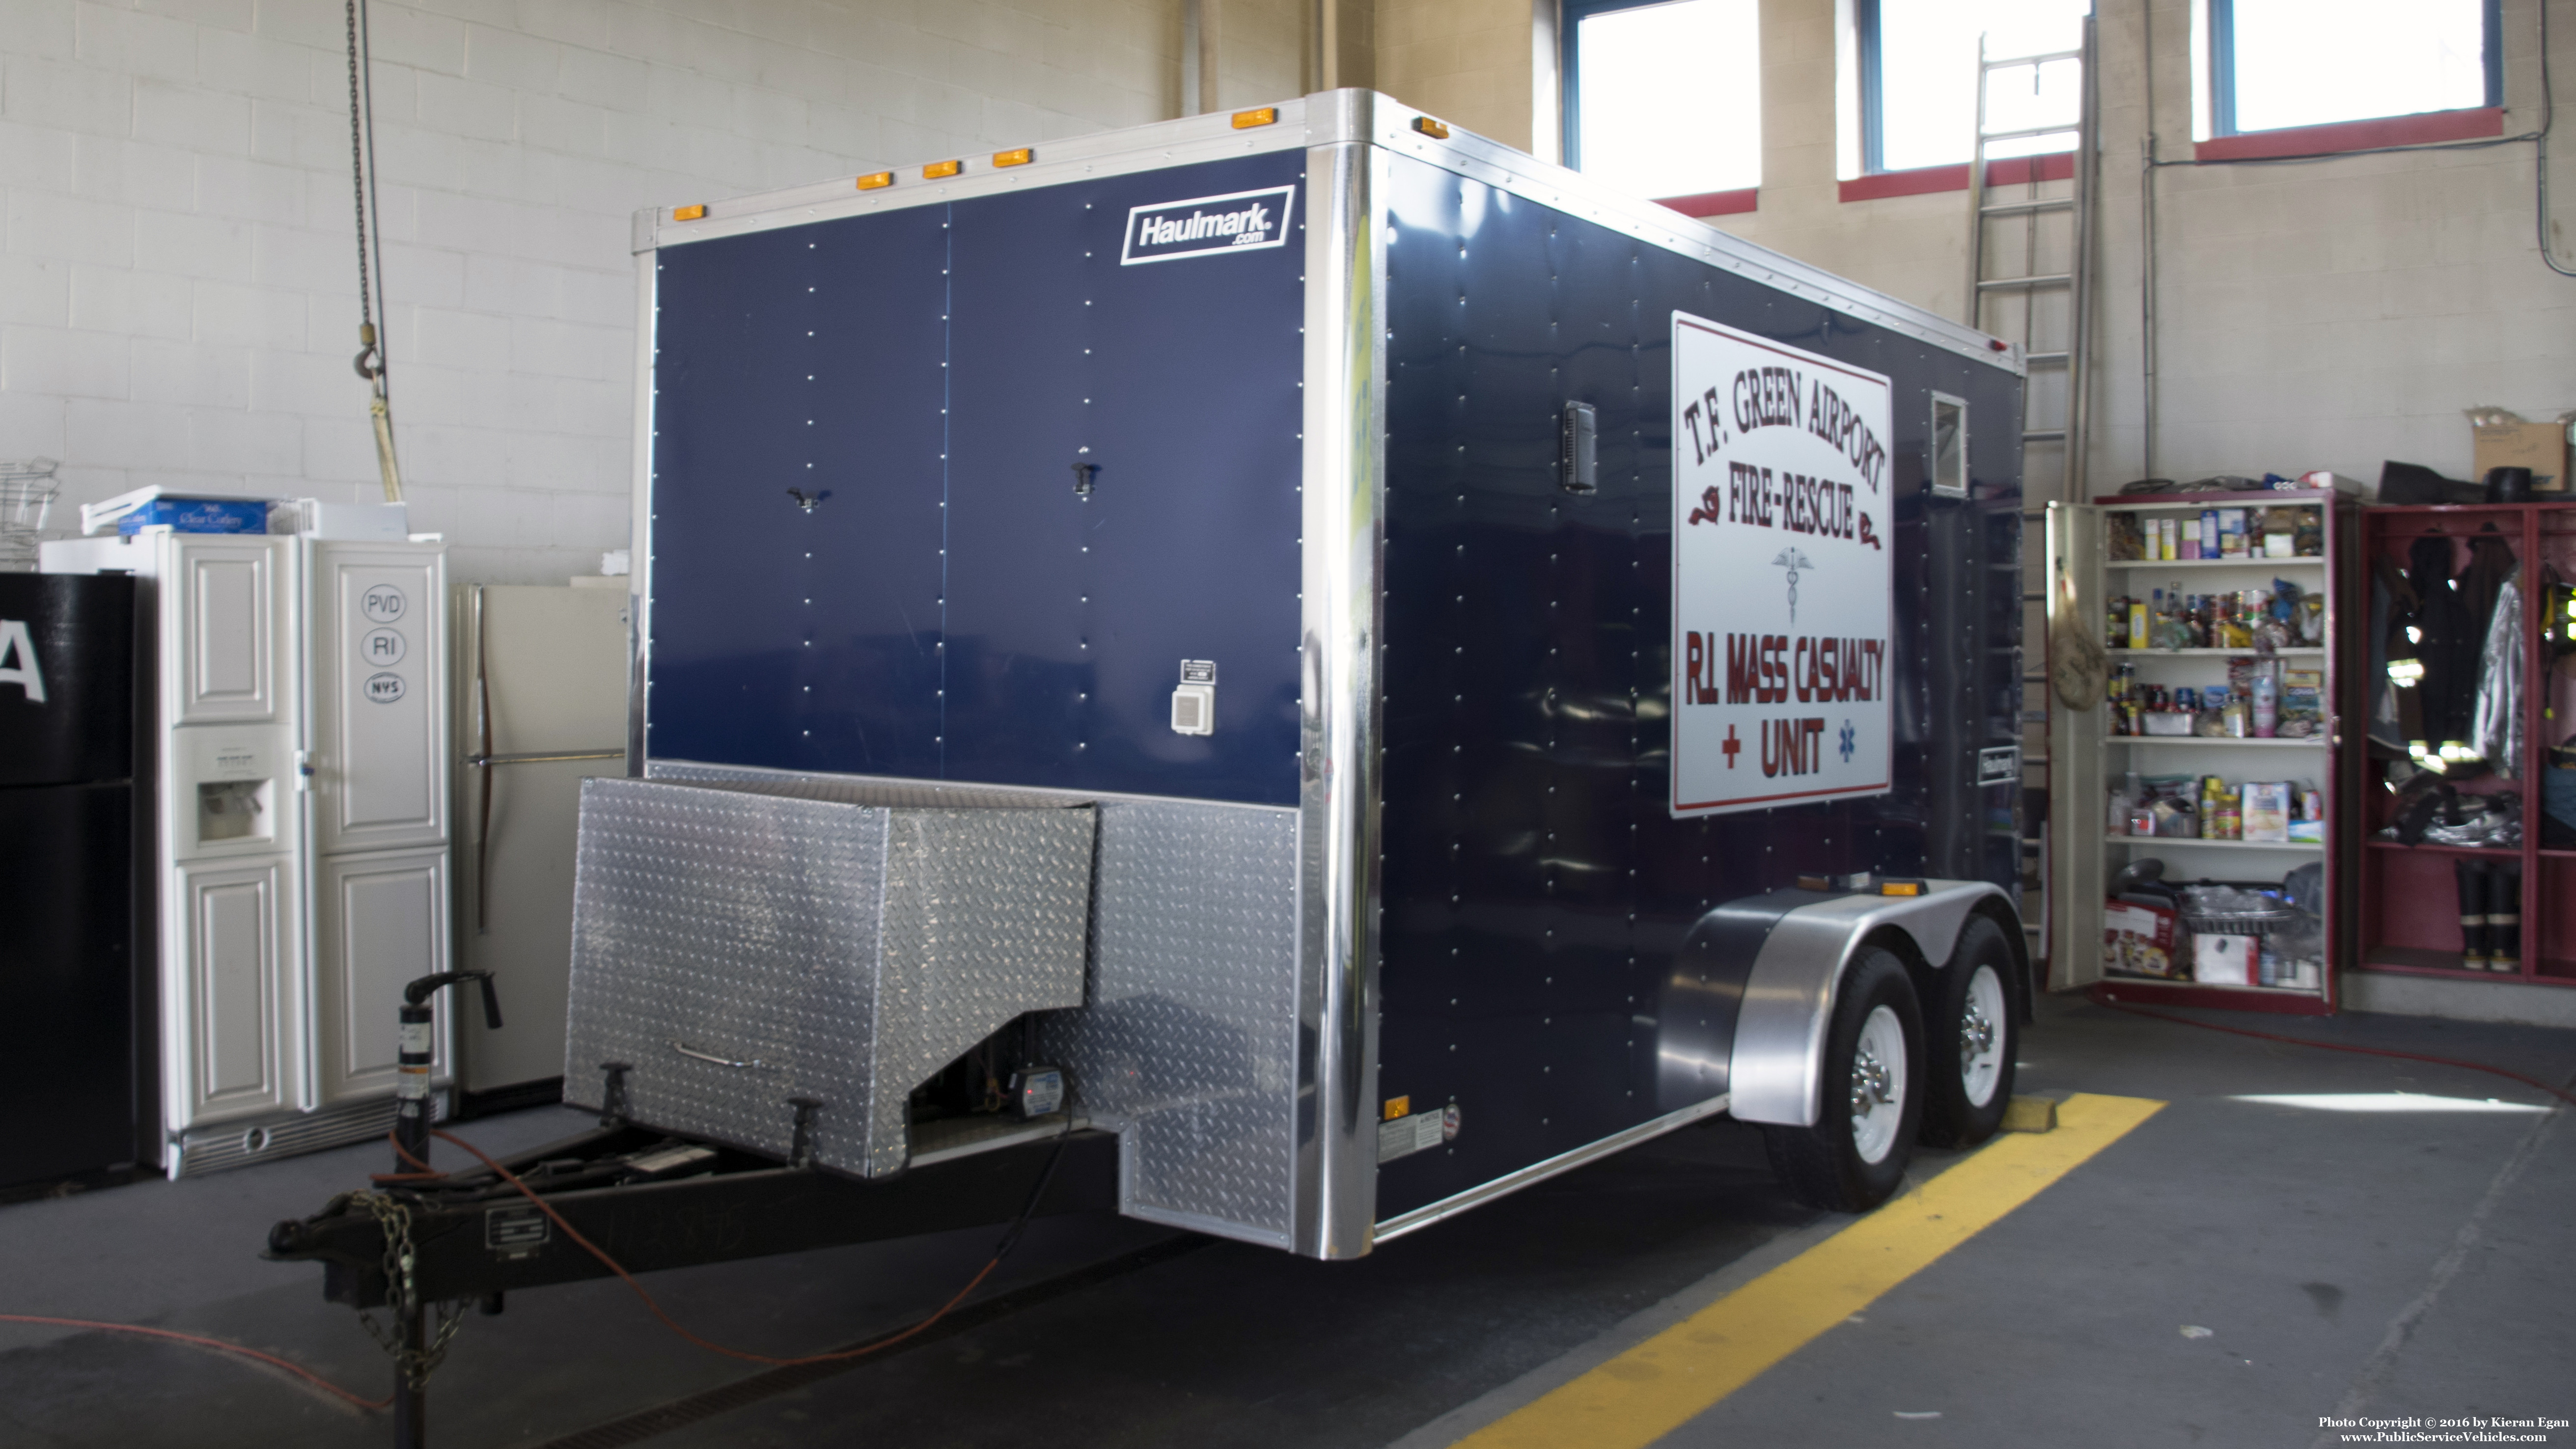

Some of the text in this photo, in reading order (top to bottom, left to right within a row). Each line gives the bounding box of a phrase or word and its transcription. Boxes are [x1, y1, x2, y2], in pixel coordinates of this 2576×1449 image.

[1139, 203, 1269, 246] Haulmark
[1232, 231, 1264, 245] .com
[1684, 367, 1885, 495] T.F. GREEN AIRPORT
[1729, 460, 1854, 540] FIRE-RESCUE
[368, 594, 400, 613] PVD
[373, 637, 395, 656] RI
[1687, 631, 1885, 705] R.I. MASS CASUALTY
[372, 681, 399, 693] NYS
[1761, 718, 1825, 778] UNIT
